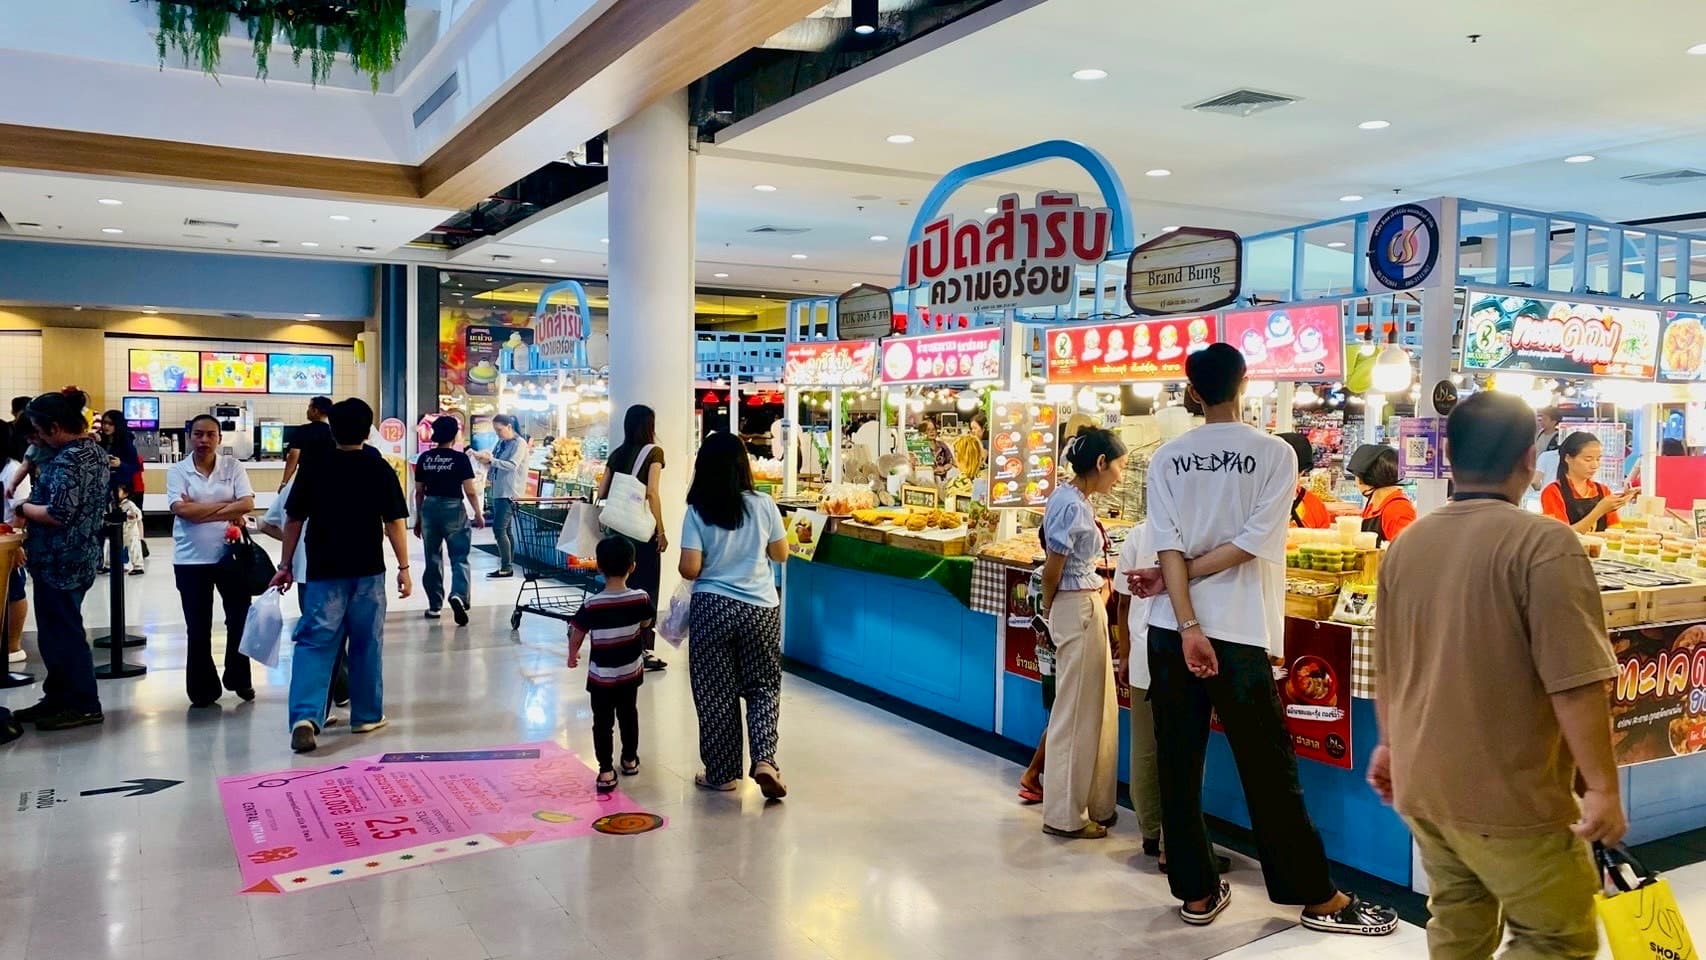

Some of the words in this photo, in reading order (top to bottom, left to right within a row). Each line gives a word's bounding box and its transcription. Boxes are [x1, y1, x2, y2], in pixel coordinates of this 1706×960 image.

[908, 195, 1107, 286] เปิดสำรับ
[931, 259, 1071, 305] ความอร่อย
[1148, 267, 1183, 287] Brand
[1187, 265, 1221, 284] Bung
[1106, 414, 1117, 423] 100
[434, 454, 453, 464] finger
[1172, 449, 1257, 475] YUEDPAO
[1296, 736, 1320, 750] ฮาลาล
[334, 821, 361, 848] ล้านบาท
[364, 815, 418, 840] 2.5
[1361, 924, 1391, 934] crocs
